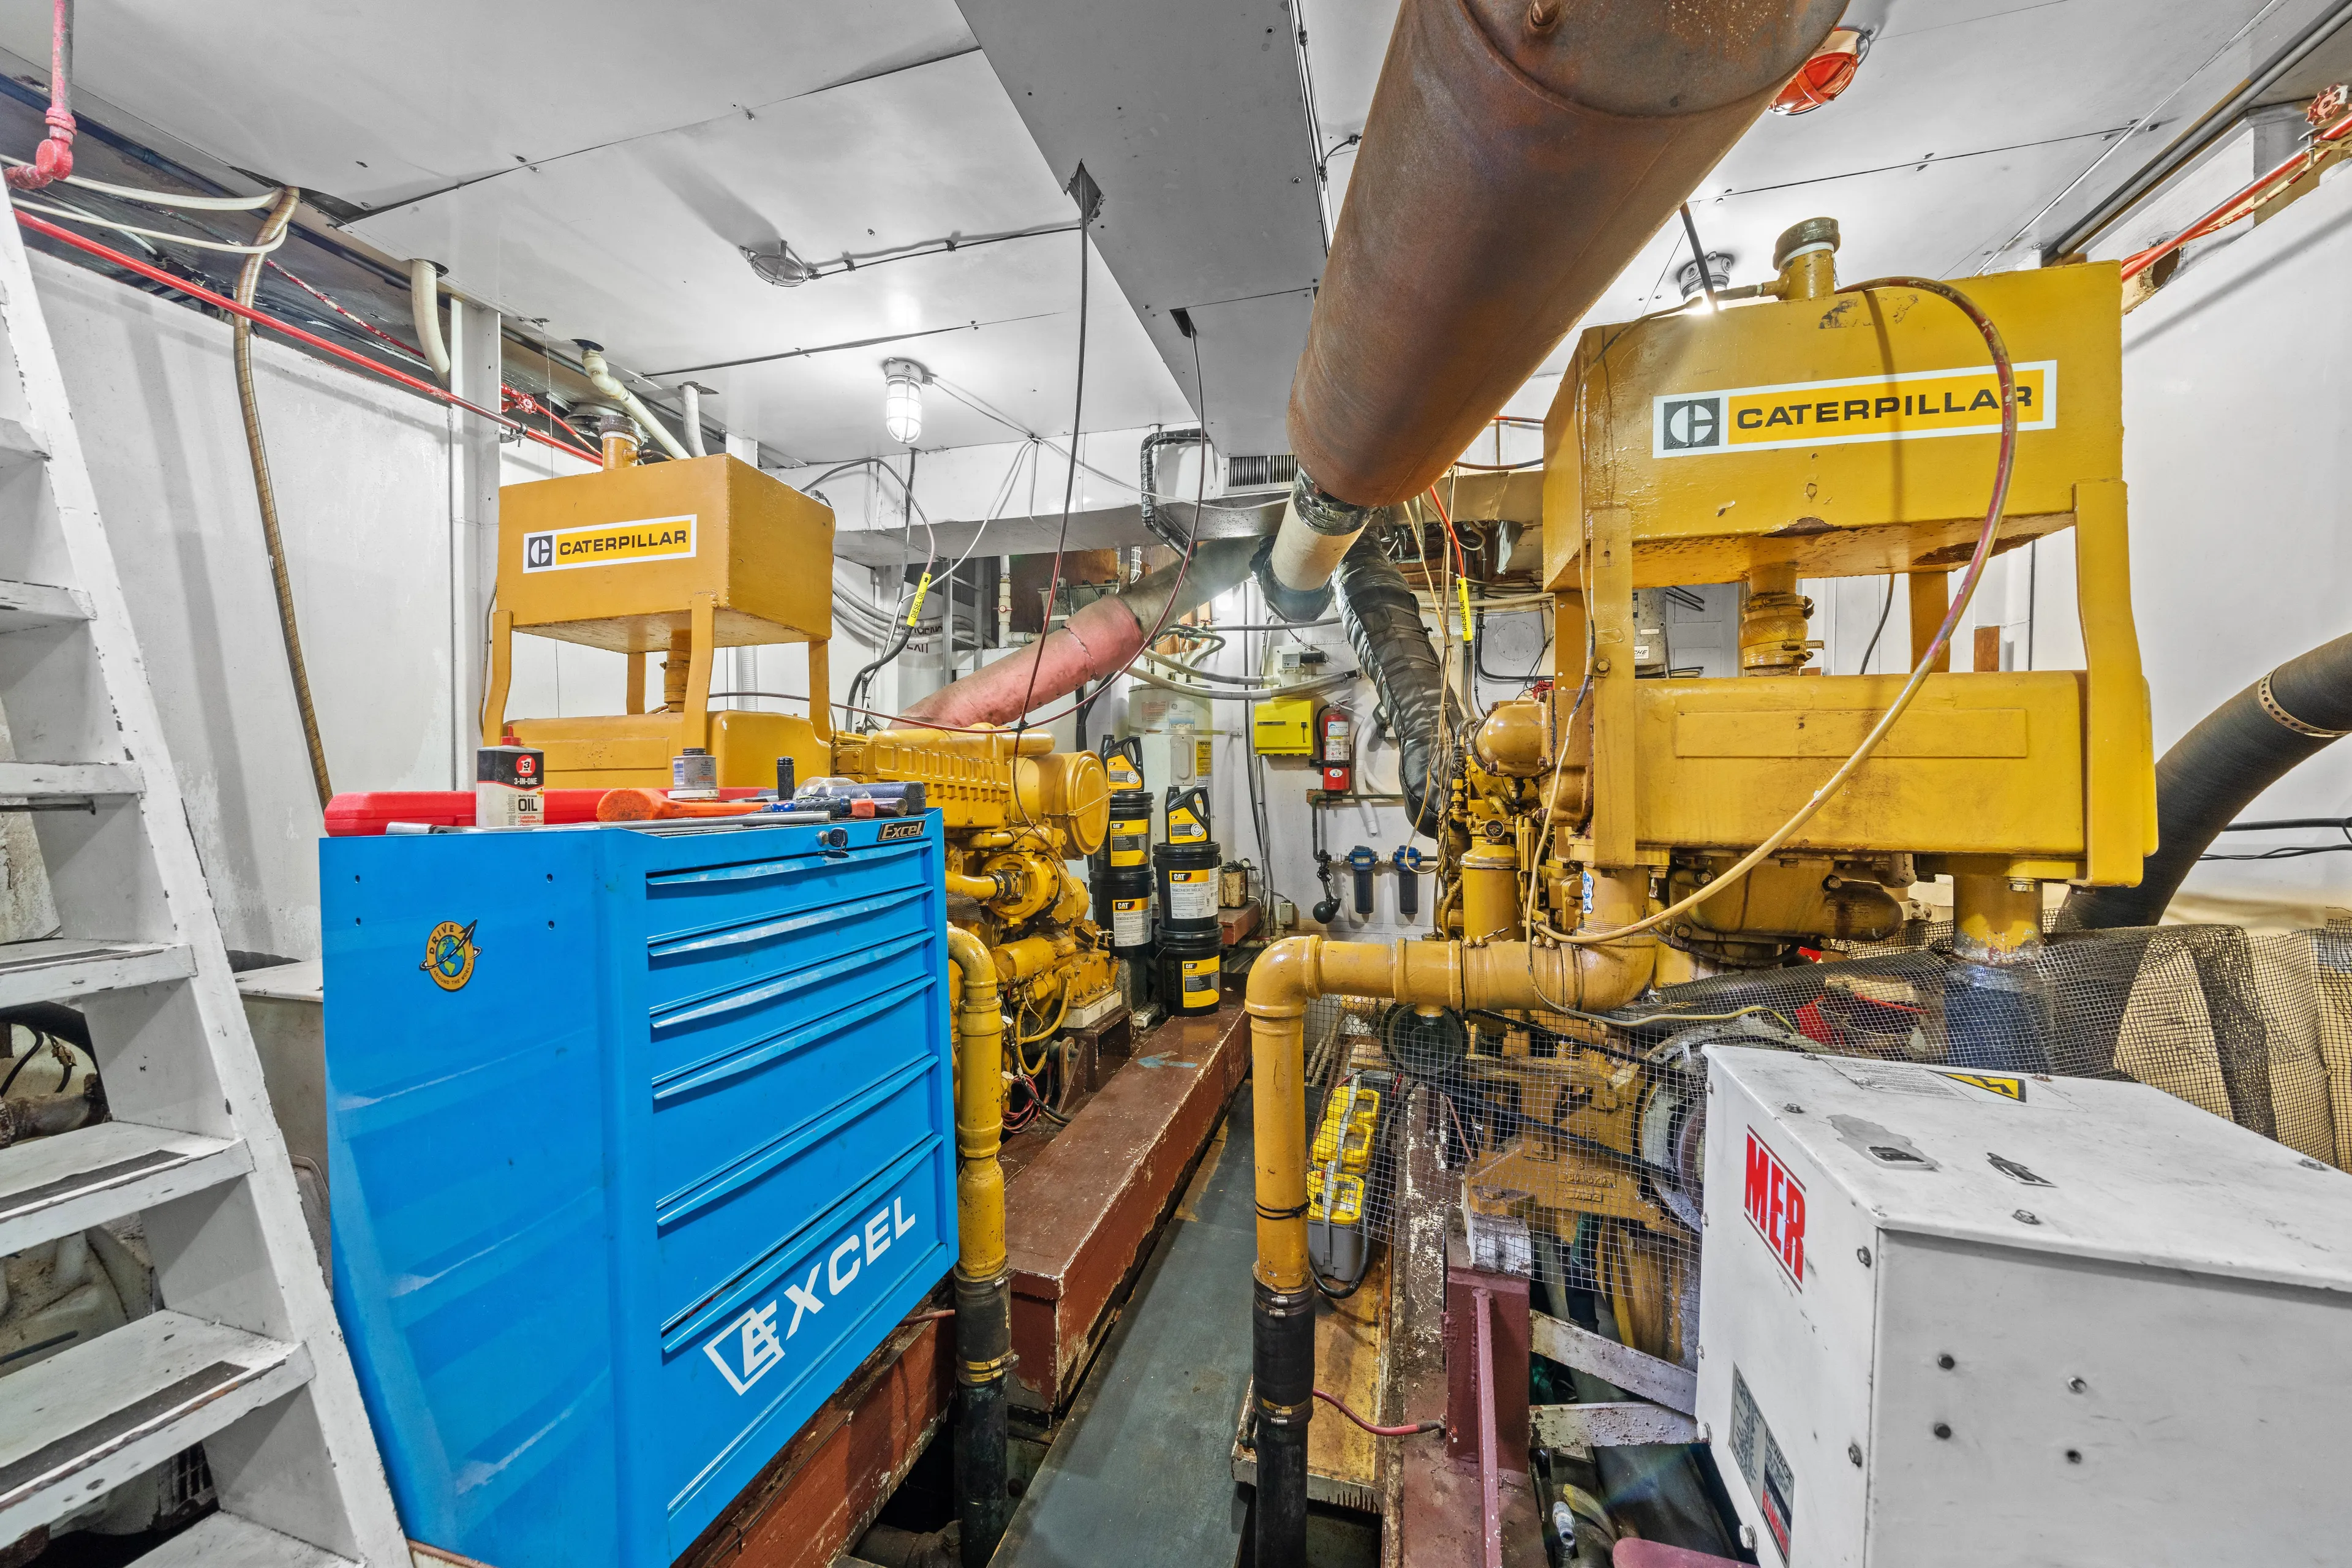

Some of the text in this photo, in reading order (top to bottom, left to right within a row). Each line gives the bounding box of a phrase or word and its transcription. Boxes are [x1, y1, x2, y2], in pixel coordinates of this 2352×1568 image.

[1736, 385, 2032, 430] CATERPILLAR
[559, 529, 687, 556] CATERPILLAR
[911, 601, 922, 619] DIESEL
[507, 794, 516, 826] ong-Lasting
[518, 798, 538, 812] OIL
[881, 821, 921, 839] Excel
[429, 924, 454, 955] DRIVE
[434, 970, 450, 985] AROUND
[461, 962, 471, 980] WORLD
[1744, 1133, 1806, 1284] MER
[735, 1196, 916, 1379] EXCEL
[1766, 1428, 1793, 1487] NEWAGE
